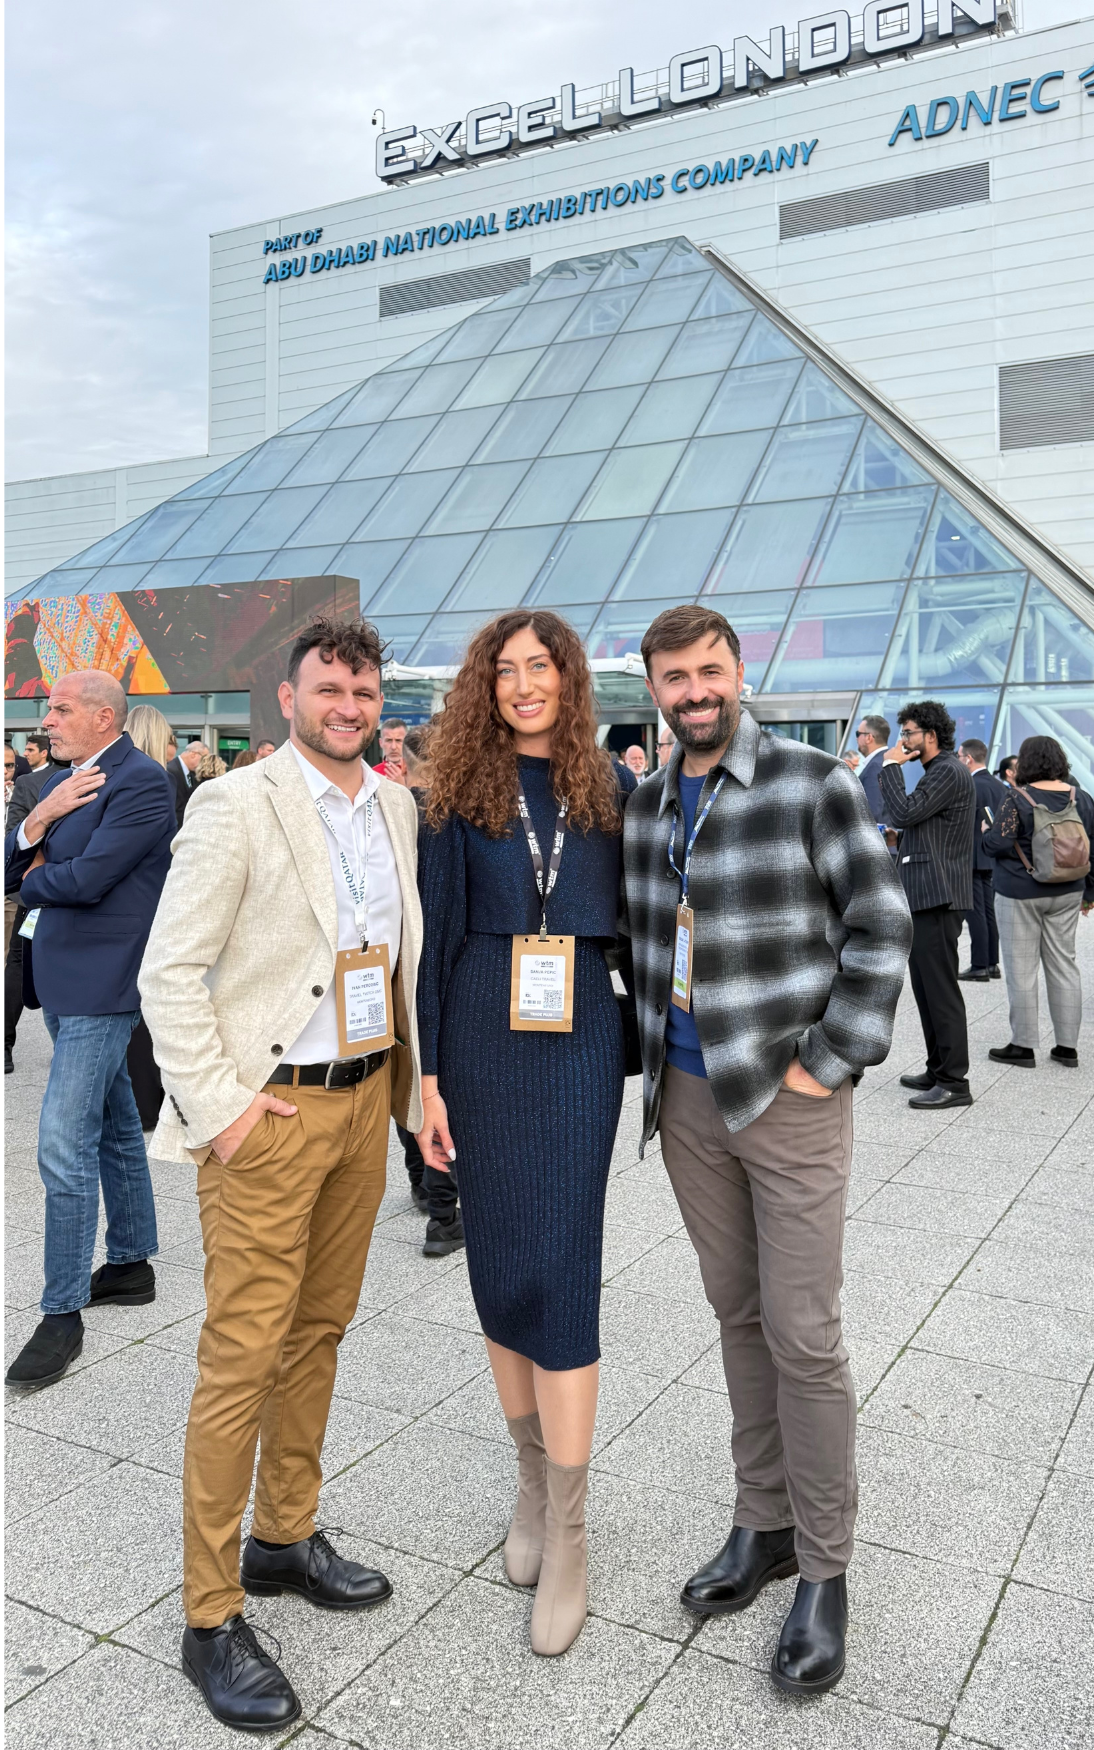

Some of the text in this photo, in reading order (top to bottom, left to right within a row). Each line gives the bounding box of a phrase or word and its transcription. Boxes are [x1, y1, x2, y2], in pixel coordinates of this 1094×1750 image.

[888, 70, 1065, 145] ADNEC
[263, 139, 819, 284] ABU DHABI NATIONAL EXHIBITIONS COMPANY
[263, 228, 322, 254] PART OF
